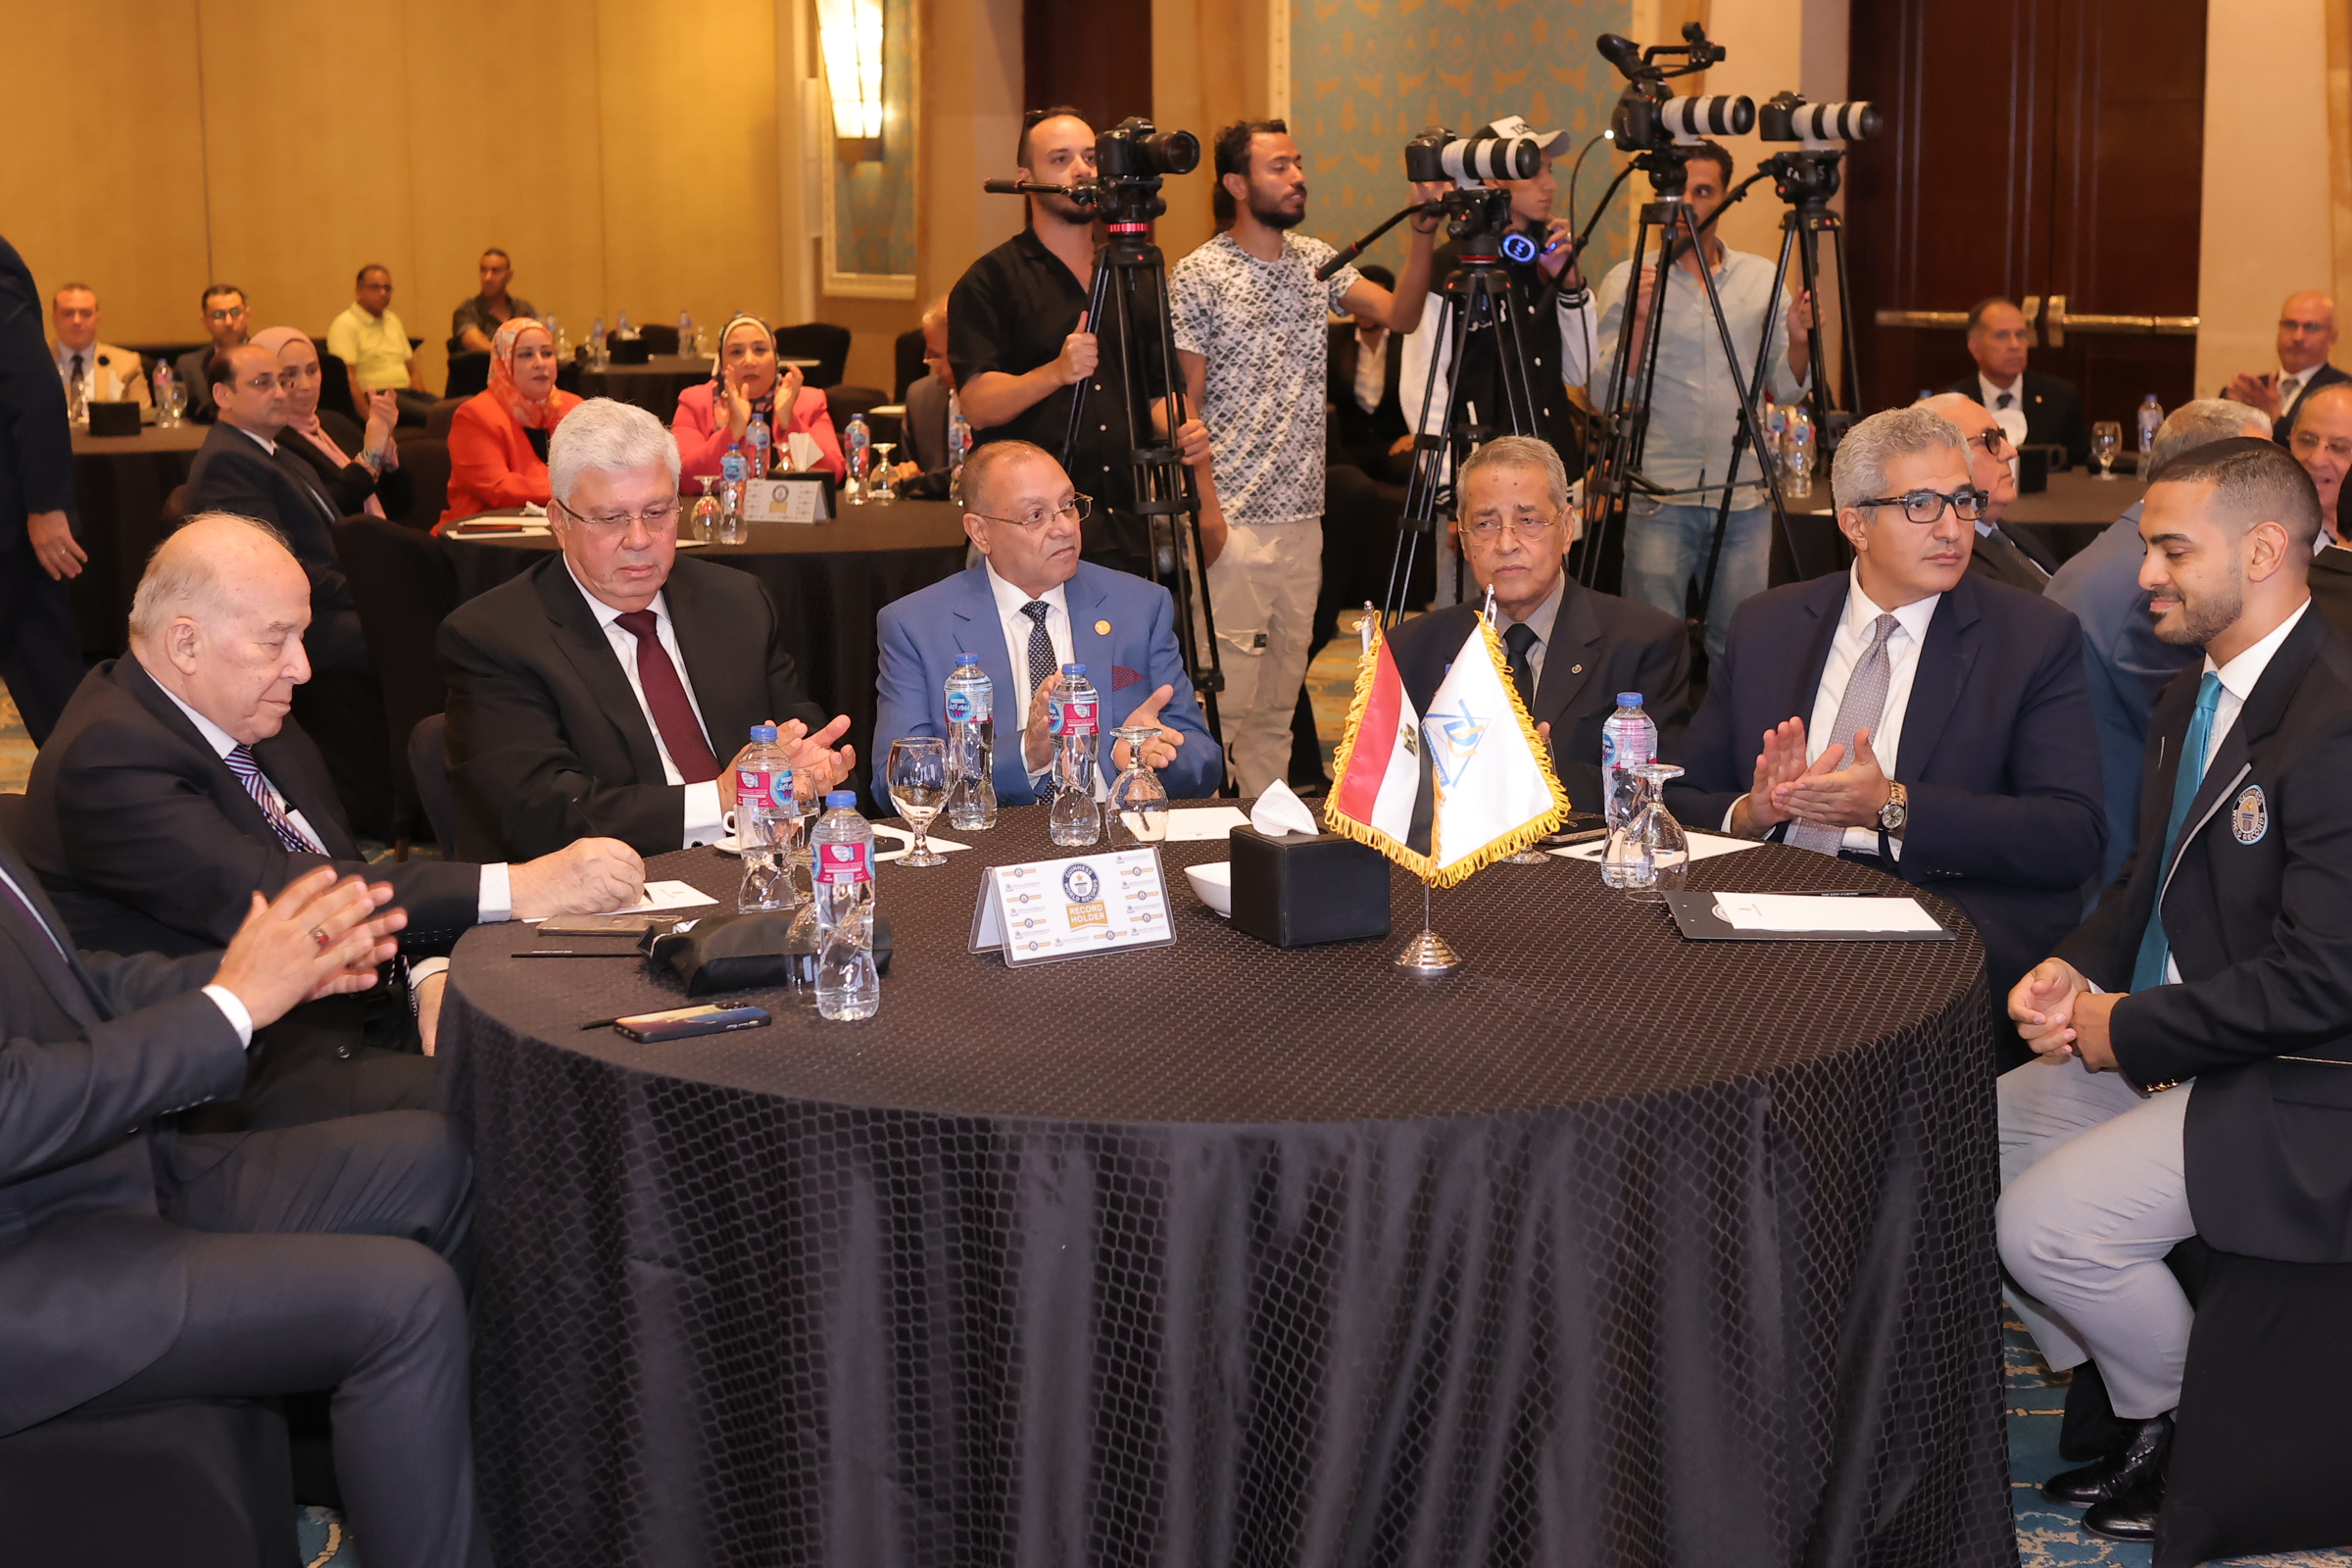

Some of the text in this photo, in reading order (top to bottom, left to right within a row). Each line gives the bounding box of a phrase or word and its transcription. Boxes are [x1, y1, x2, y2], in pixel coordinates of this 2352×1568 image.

[2242, 811, 2265, 841] RECORDS
[1064, 864, 1094, 878] GUINNESS
[1063, 883, 1081, 902] WORLD
[1081, 878, 1099, 903] RECORDS
[1069, 904, 1103, 915] RECORD
[1070, 911, 1105, 923] HOLDER
